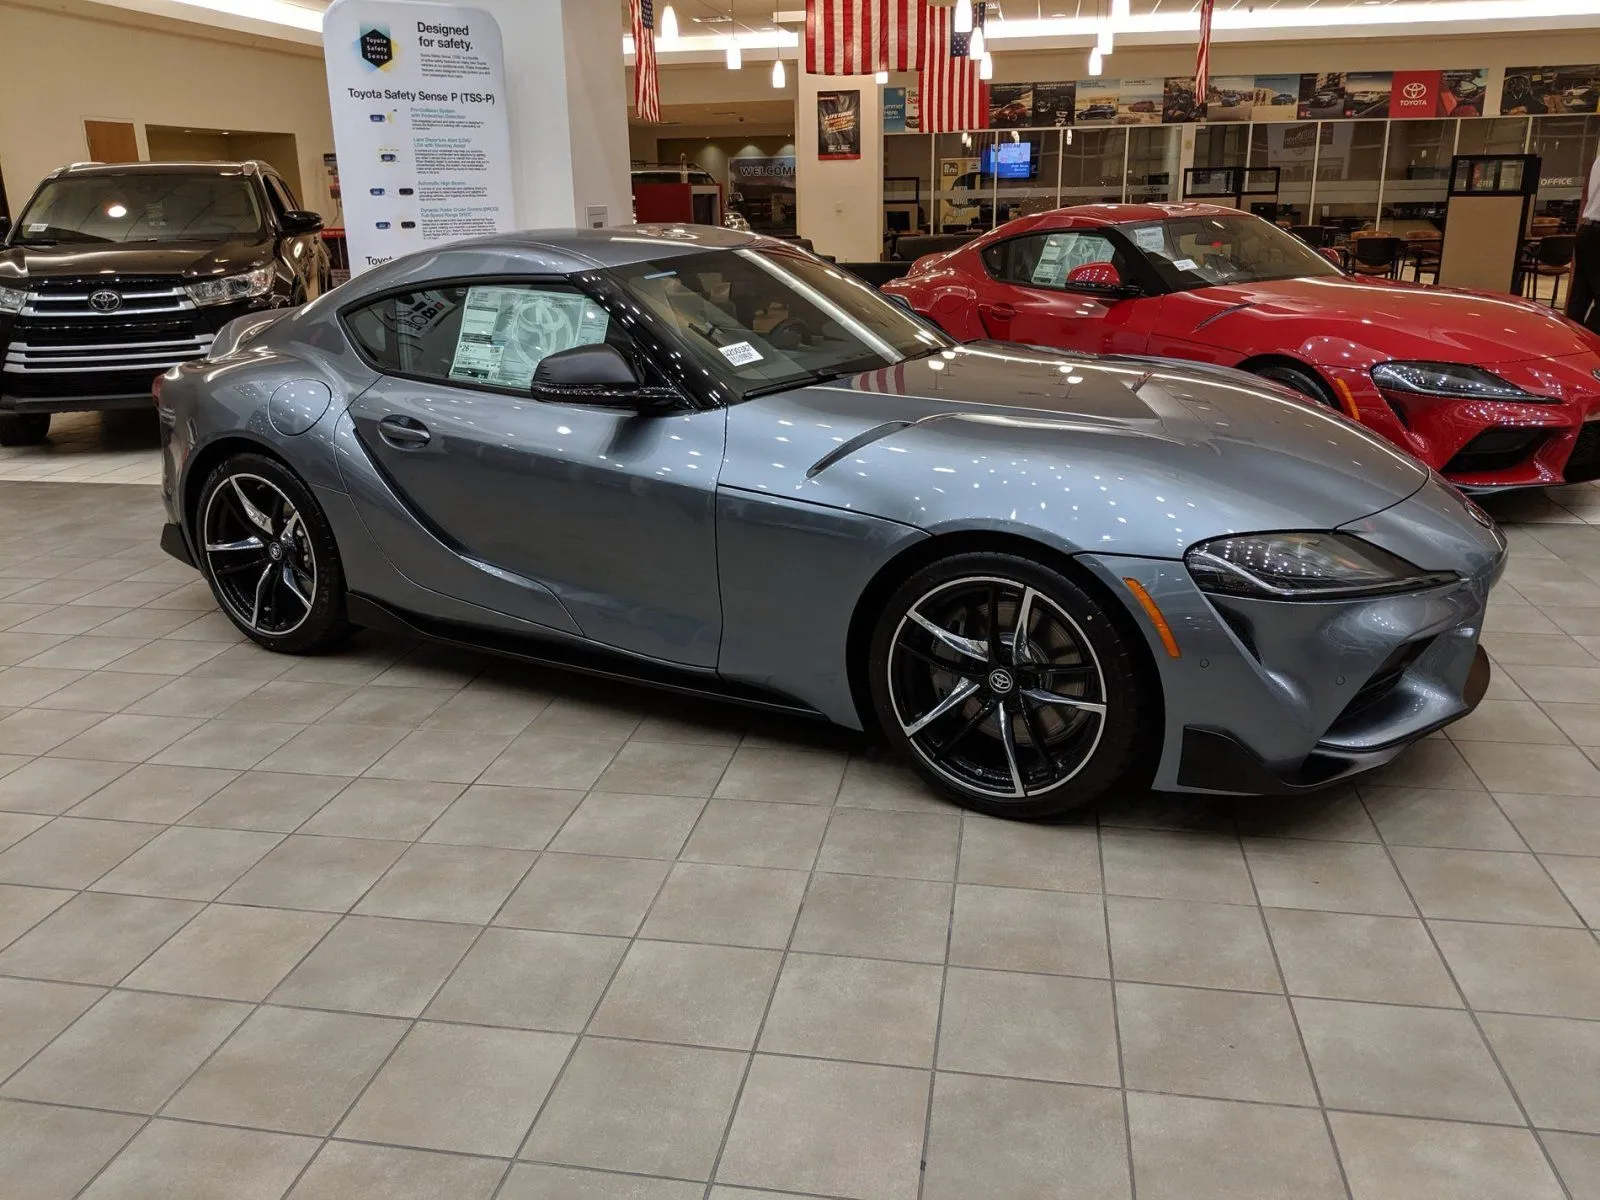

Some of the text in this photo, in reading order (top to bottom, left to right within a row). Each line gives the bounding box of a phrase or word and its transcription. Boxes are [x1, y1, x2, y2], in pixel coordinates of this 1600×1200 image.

[417, 21, 470, 37] Designed
[366, 37, 387, 45] Toyota
[419, 36, 474, 52] for safety.
[348, 88, 495, 105] Toyota Safety Sense P (TSS-P)
[1540, 177, 1573, 186] OFFICE
